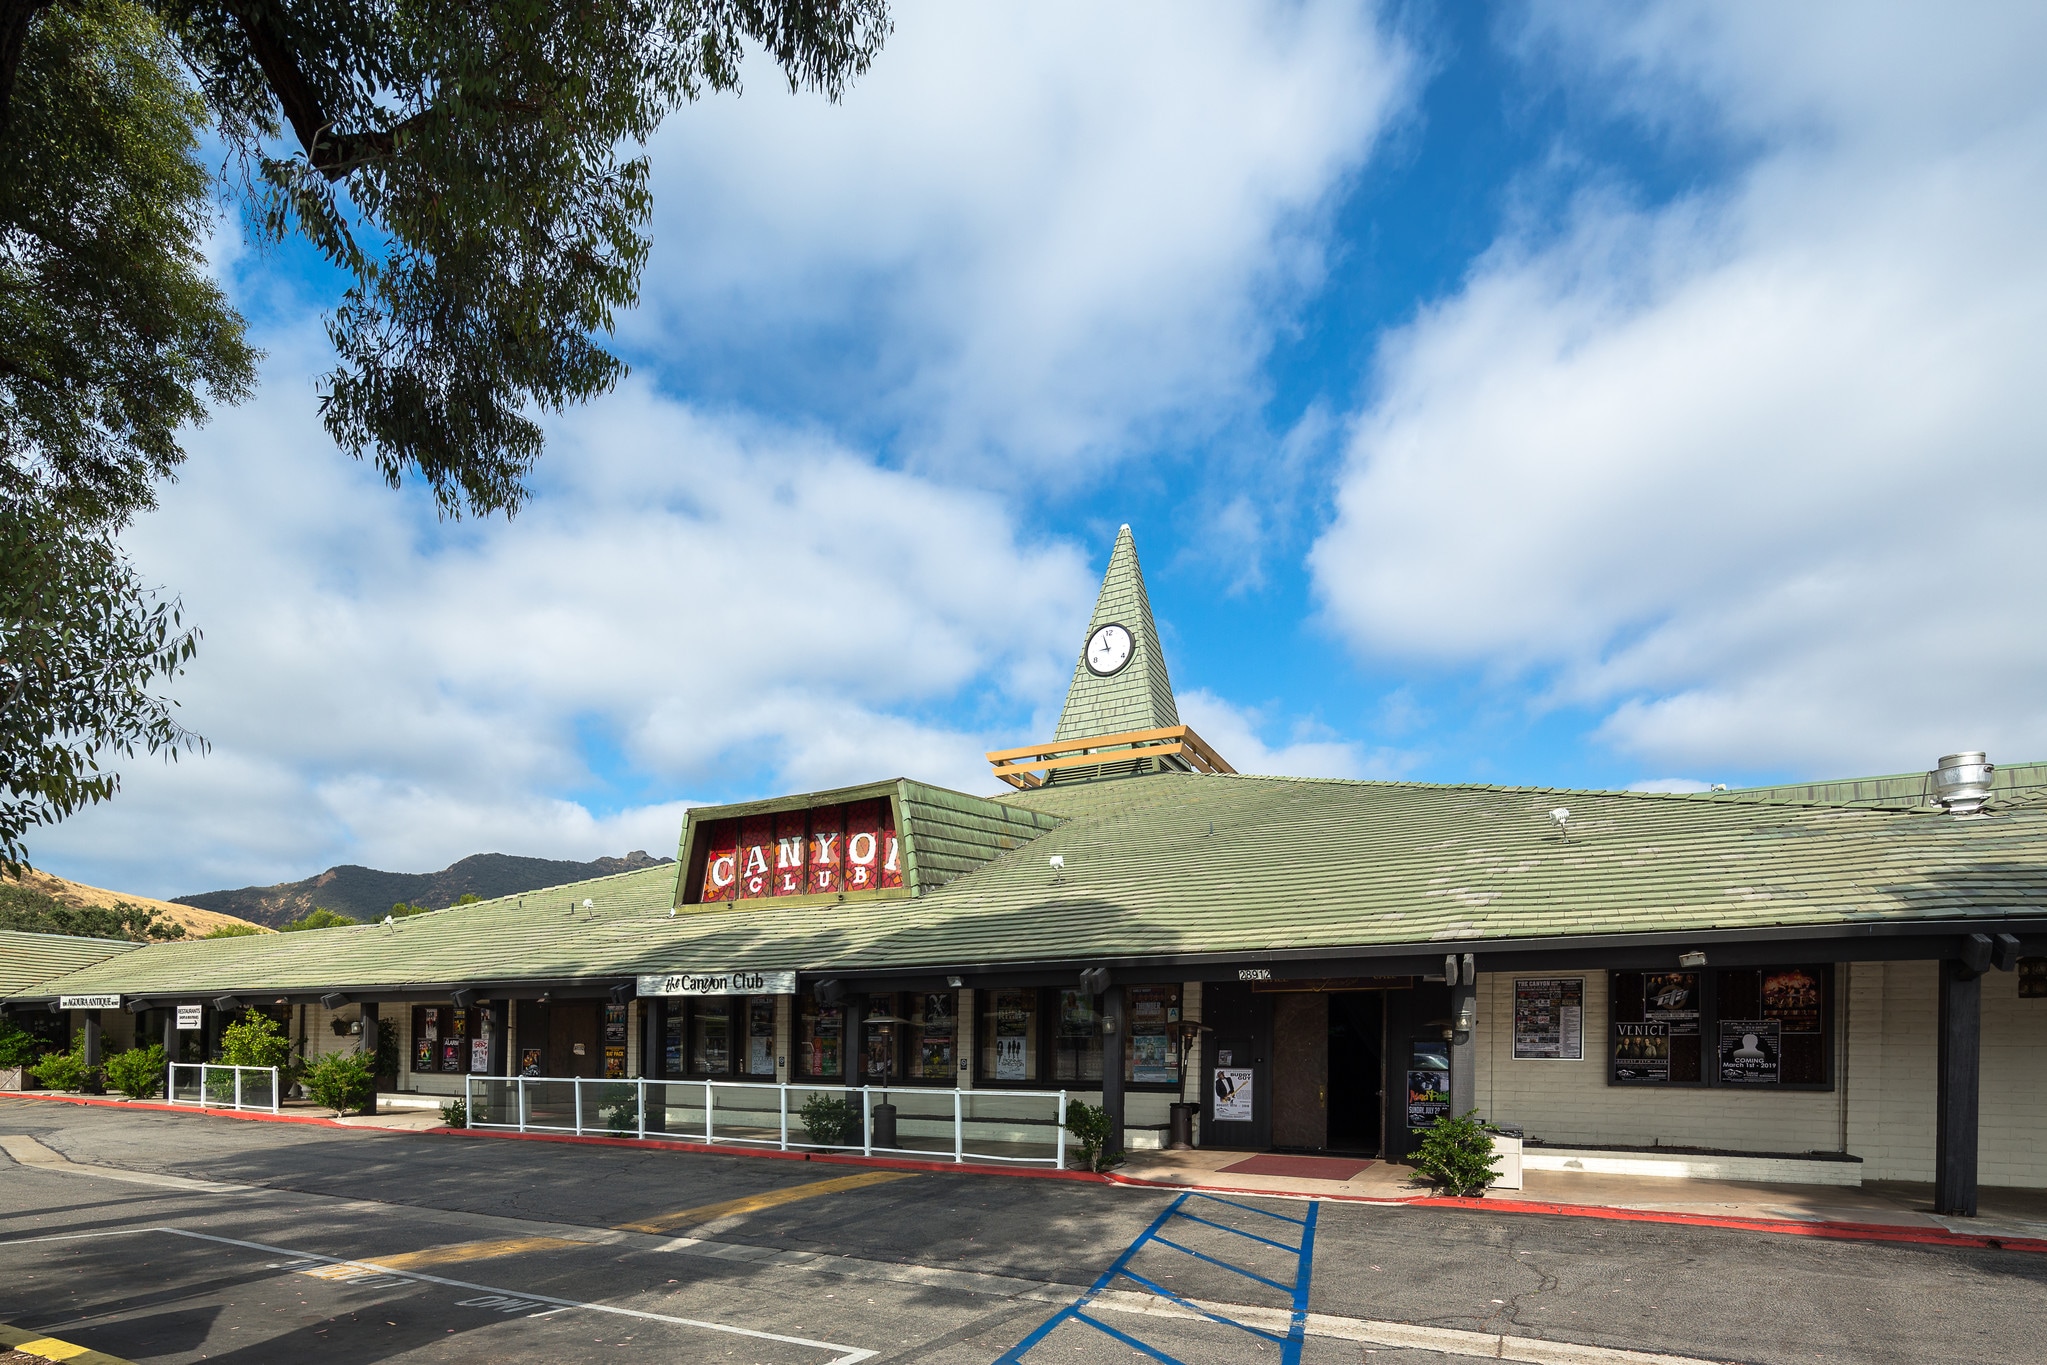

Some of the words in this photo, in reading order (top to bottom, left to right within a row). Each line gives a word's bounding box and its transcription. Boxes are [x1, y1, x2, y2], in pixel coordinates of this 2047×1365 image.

[1105, 629, 1114, 637] 12
[749, 866, 867, 893] CLUB
[1239, 969, 1271, 980] 28912
[666, 977, 680, 993] the
[681, 975, 727, 994] Canyon
[733, 973, 763, 989] Club
[68, 998, 89, 1006] AGOURA
[89, 997, 111, 1007] ANTIQUE
[1617, 1024, 1666, 1036] VENICE
